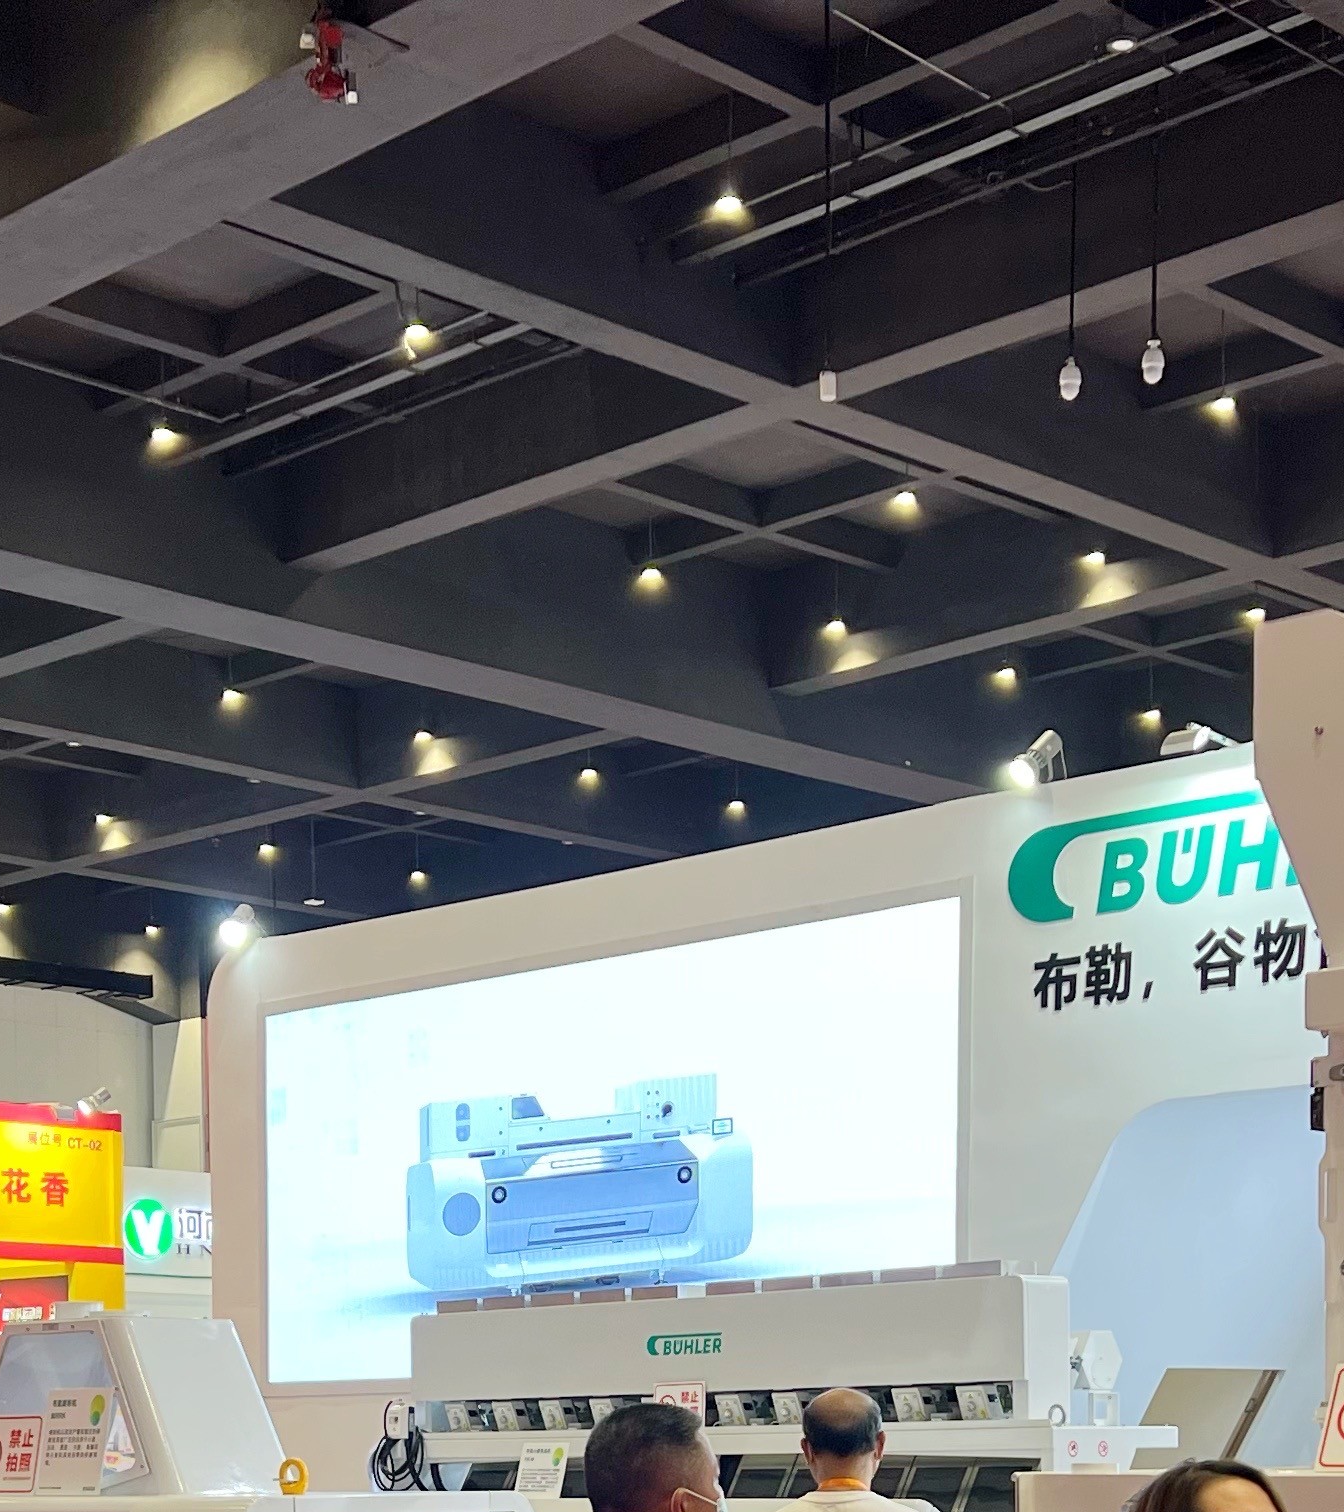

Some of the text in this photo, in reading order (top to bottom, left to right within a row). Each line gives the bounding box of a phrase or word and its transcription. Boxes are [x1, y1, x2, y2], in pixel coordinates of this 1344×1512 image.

[1096, 818, 1299, 915] BÜH
[67, 1137, 103, 1151] CT-02
[9, 1428, 34, 1449] 禁止
[5, 1452, 33, 1472] 拍照
